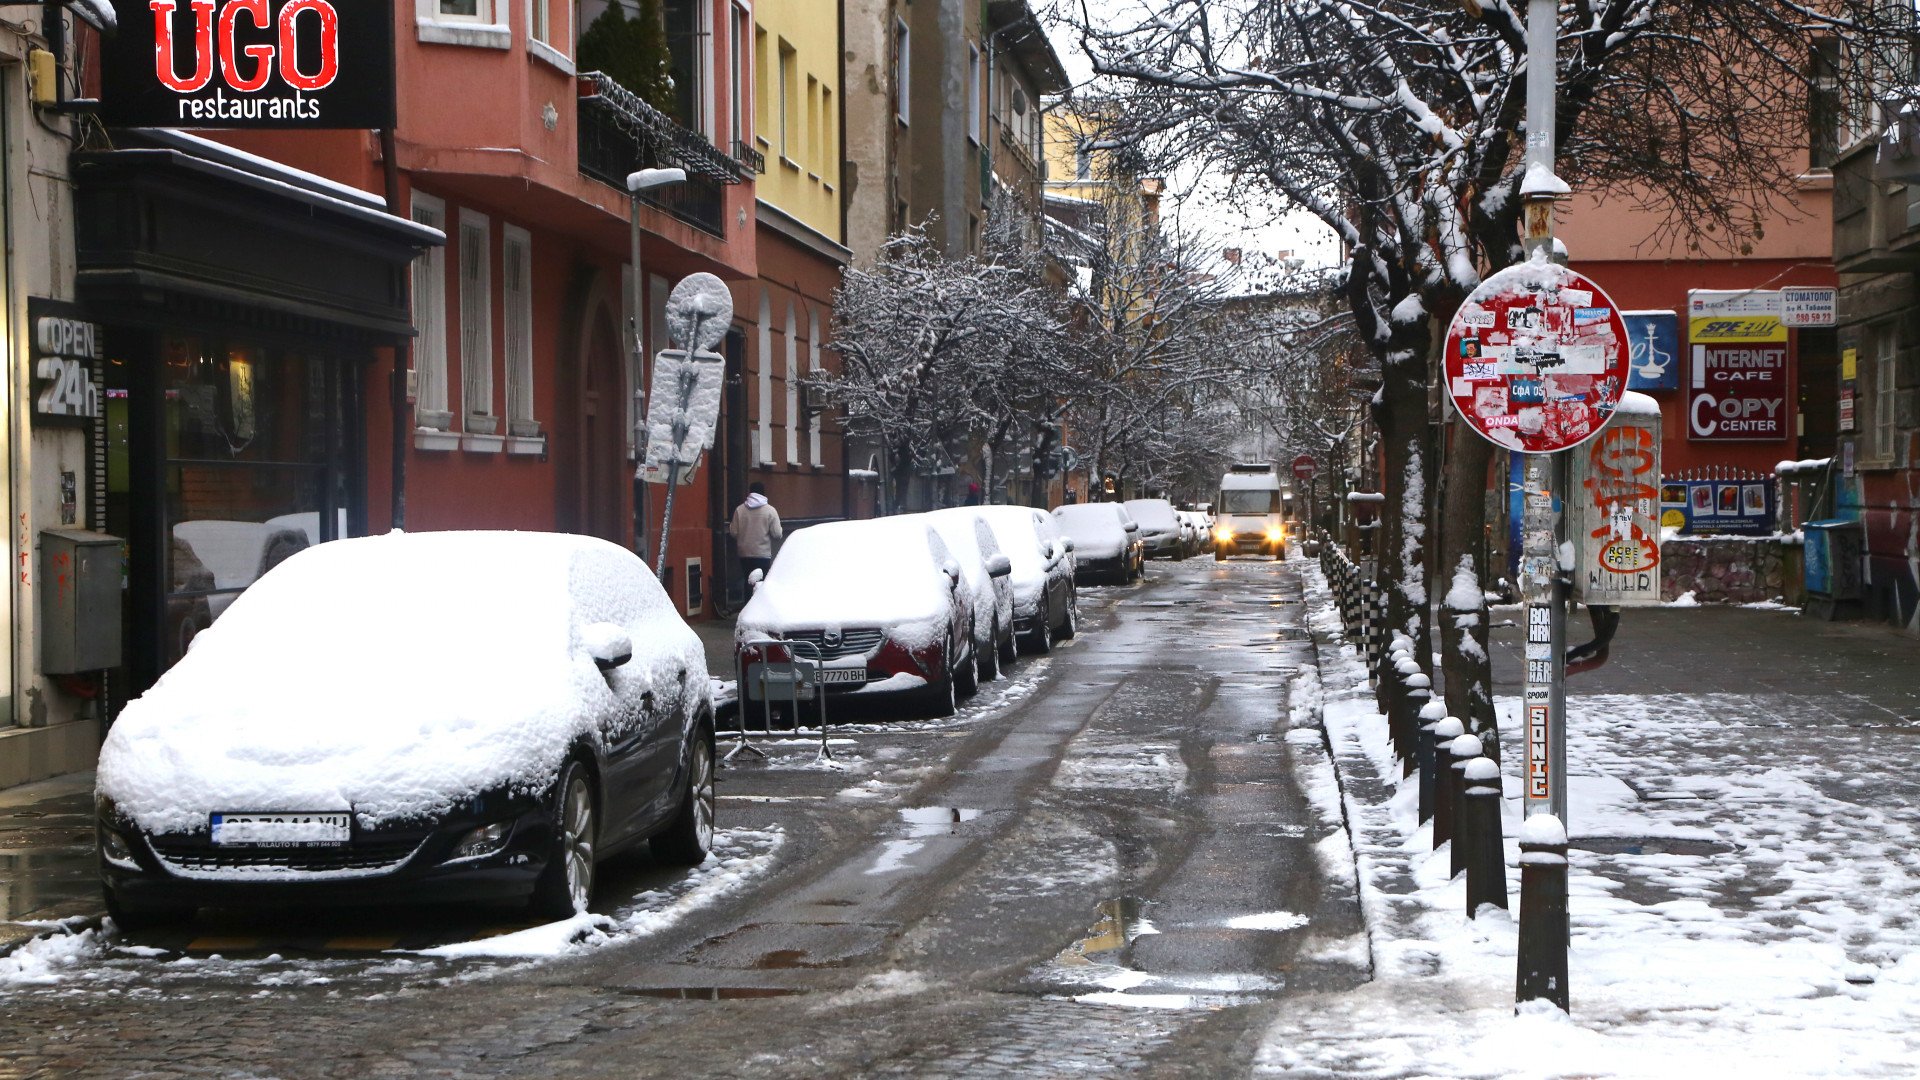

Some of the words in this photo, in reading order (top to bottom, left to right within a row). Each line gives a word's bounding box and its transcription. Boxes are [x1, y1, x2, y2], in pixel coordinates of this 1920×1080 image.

[150, 0, 339, 93] UGO
[179, 87, 320, 119] restaurants
[38, 317, 95, 358] OPEN
[1692, 344, 1785, 389] INTERNET
[1713, 371, 1773, 380] CAFE
[37, 357, 97, 417] 24h
[1485, 417, 1519, 426] ONDA
[1691, 393, 1783, 437] COPY
[1720, 420, 1777, 431] CENTER
[823, 670, 849, 681] 7770
[1527, 691, 1549, 700] SPOON
[1531, 708, 1546, 795] SONIC
